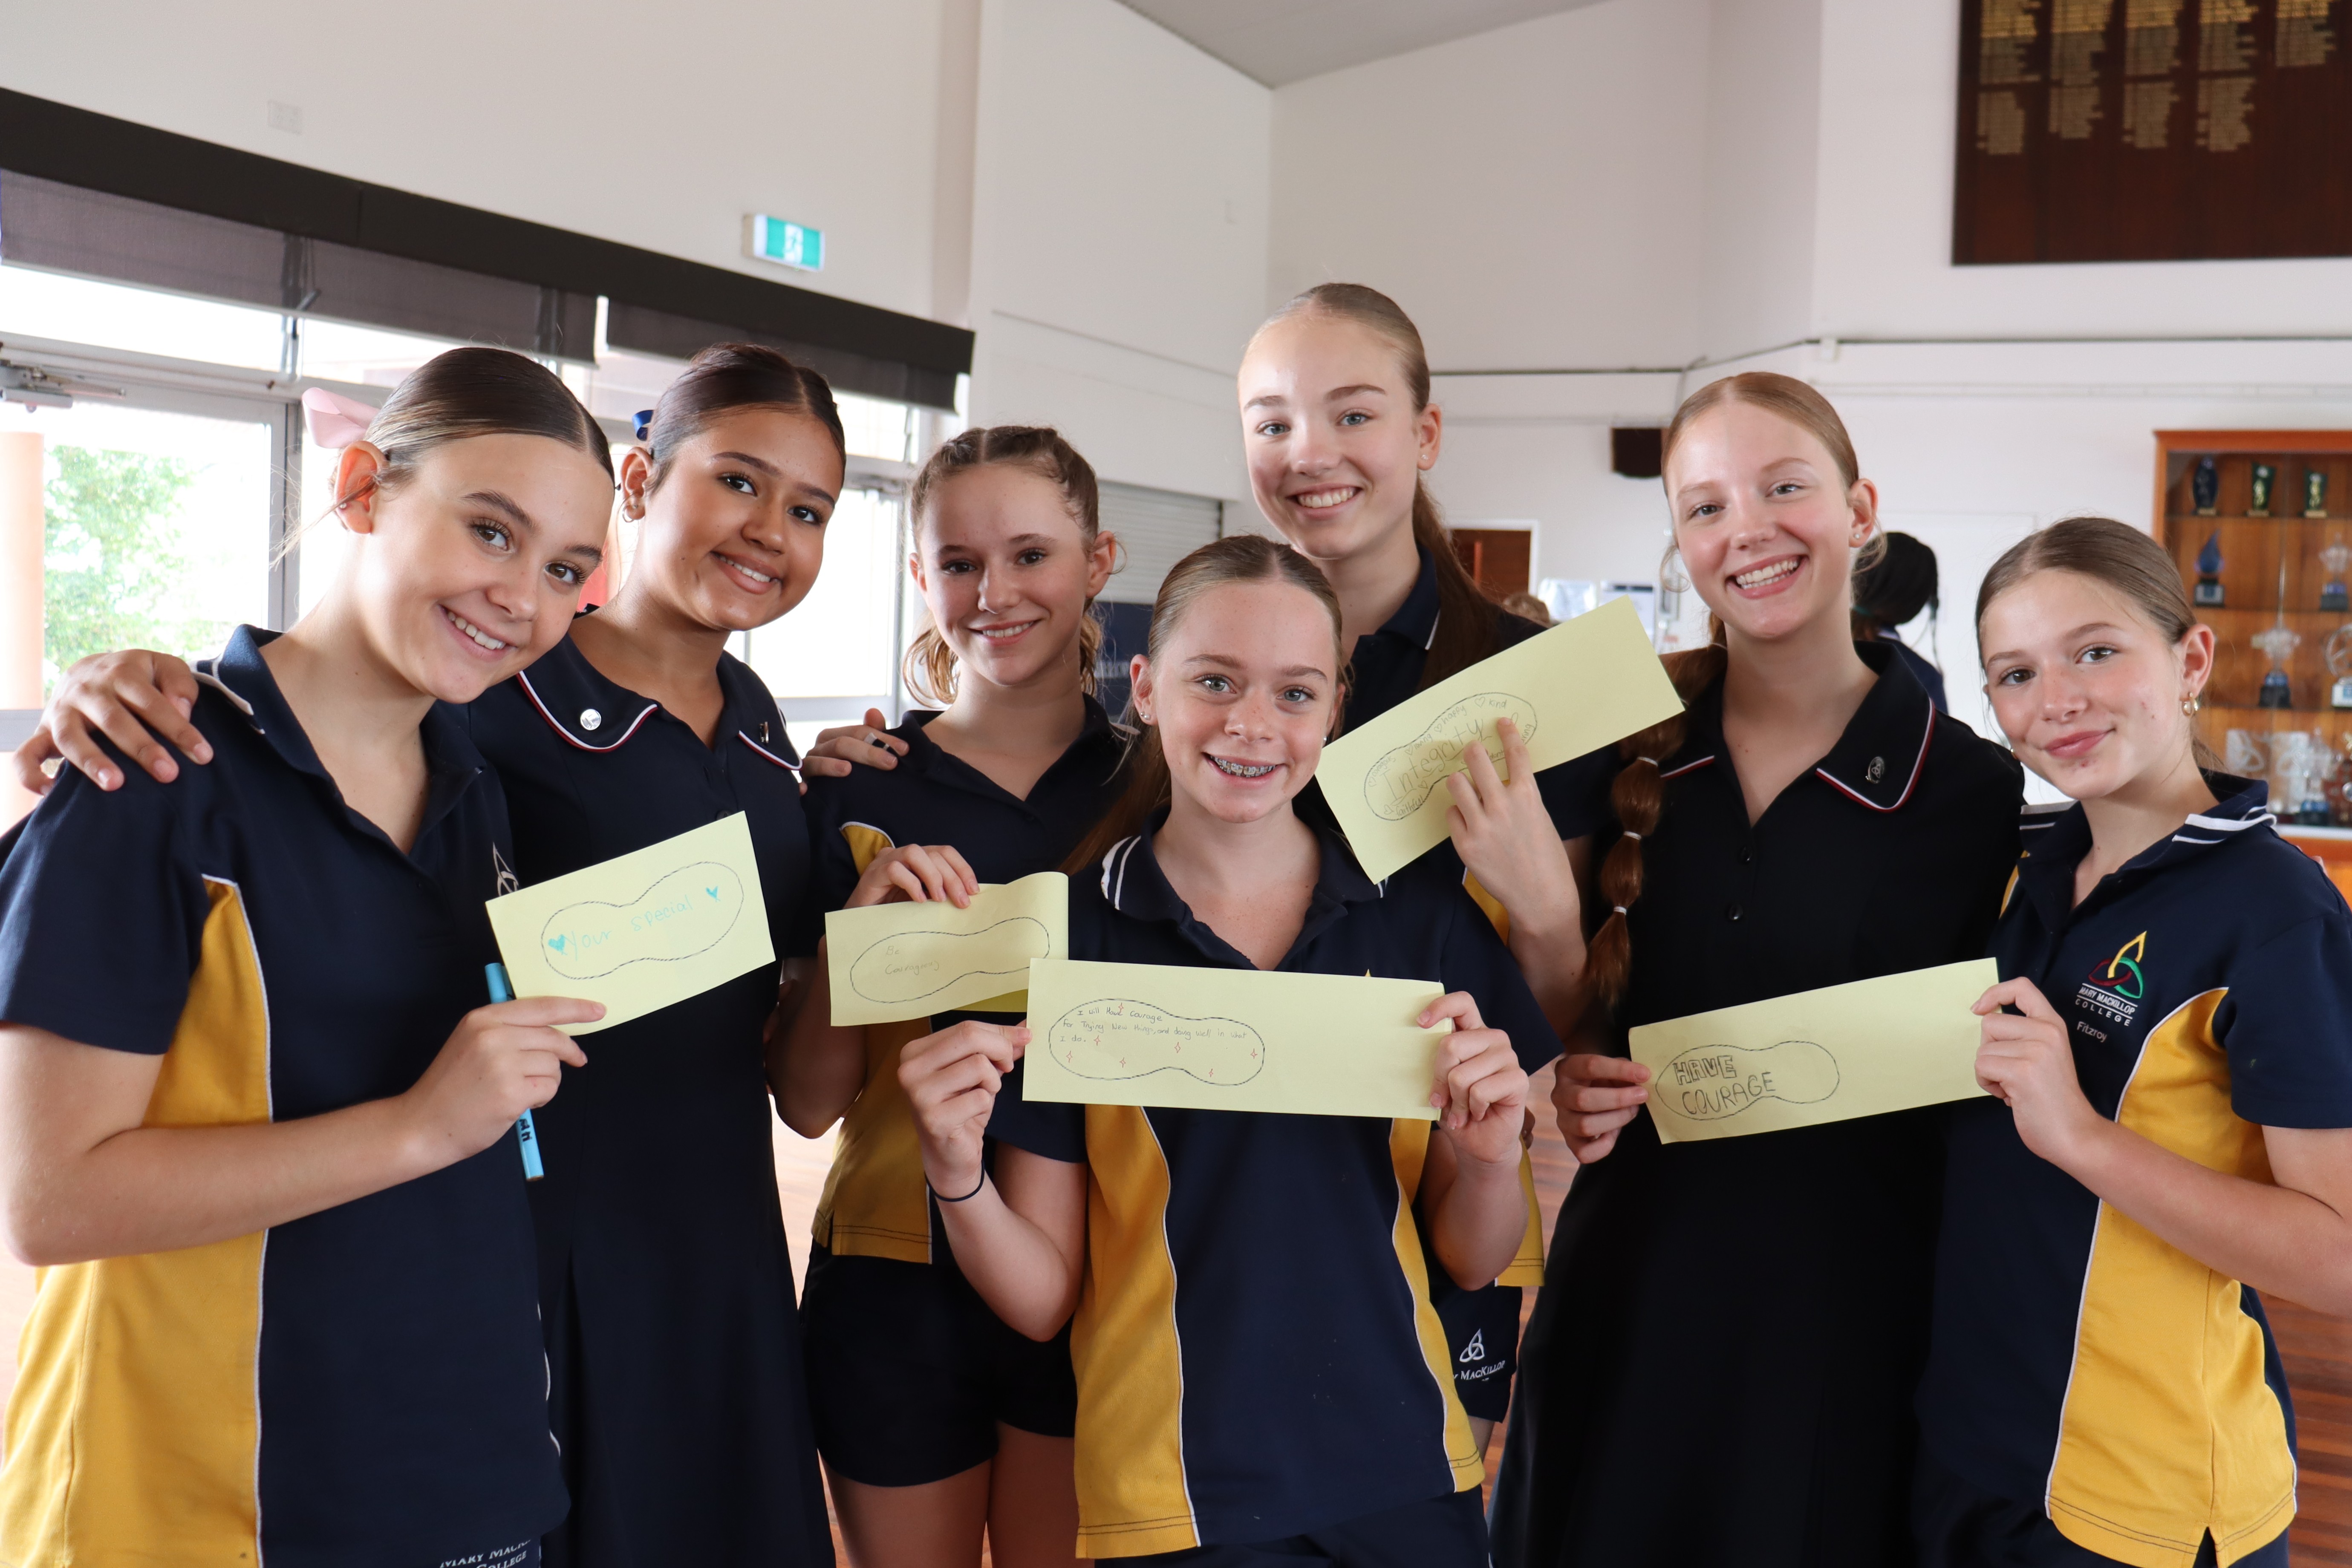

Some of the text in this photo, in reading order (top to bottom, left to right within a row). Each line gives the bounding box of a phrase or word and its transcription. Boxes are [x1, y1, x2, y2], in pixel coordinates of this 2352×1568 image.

[1441, 705, 1467, 724] happy
[1414, 733, 1433, 750] loving
[1379, 719, 1483, 800] Integrity
[1396, 794, 1425, 817] faithful
[886, 945, 900, 955] Be
[1106, 1006, 1123, 1016] Have
[2078, 986, 2136, 1015] MARY MACKILLOP
[2075, 998, 2131, 1026] COLLEGE
[1080, 1021, 1104, 1034] Trying
[1174, 1026, 1192, 1040] doing
[1195, 1029, 1212, 1038] well
[1217, 1028, 1225, 1037] in
[2076, 1021, 2107, 1043] Fitzroy
[1673, 1055, 1737, 1085] HAVE
[1682, 1071, 1776, 1115] COURAGE
